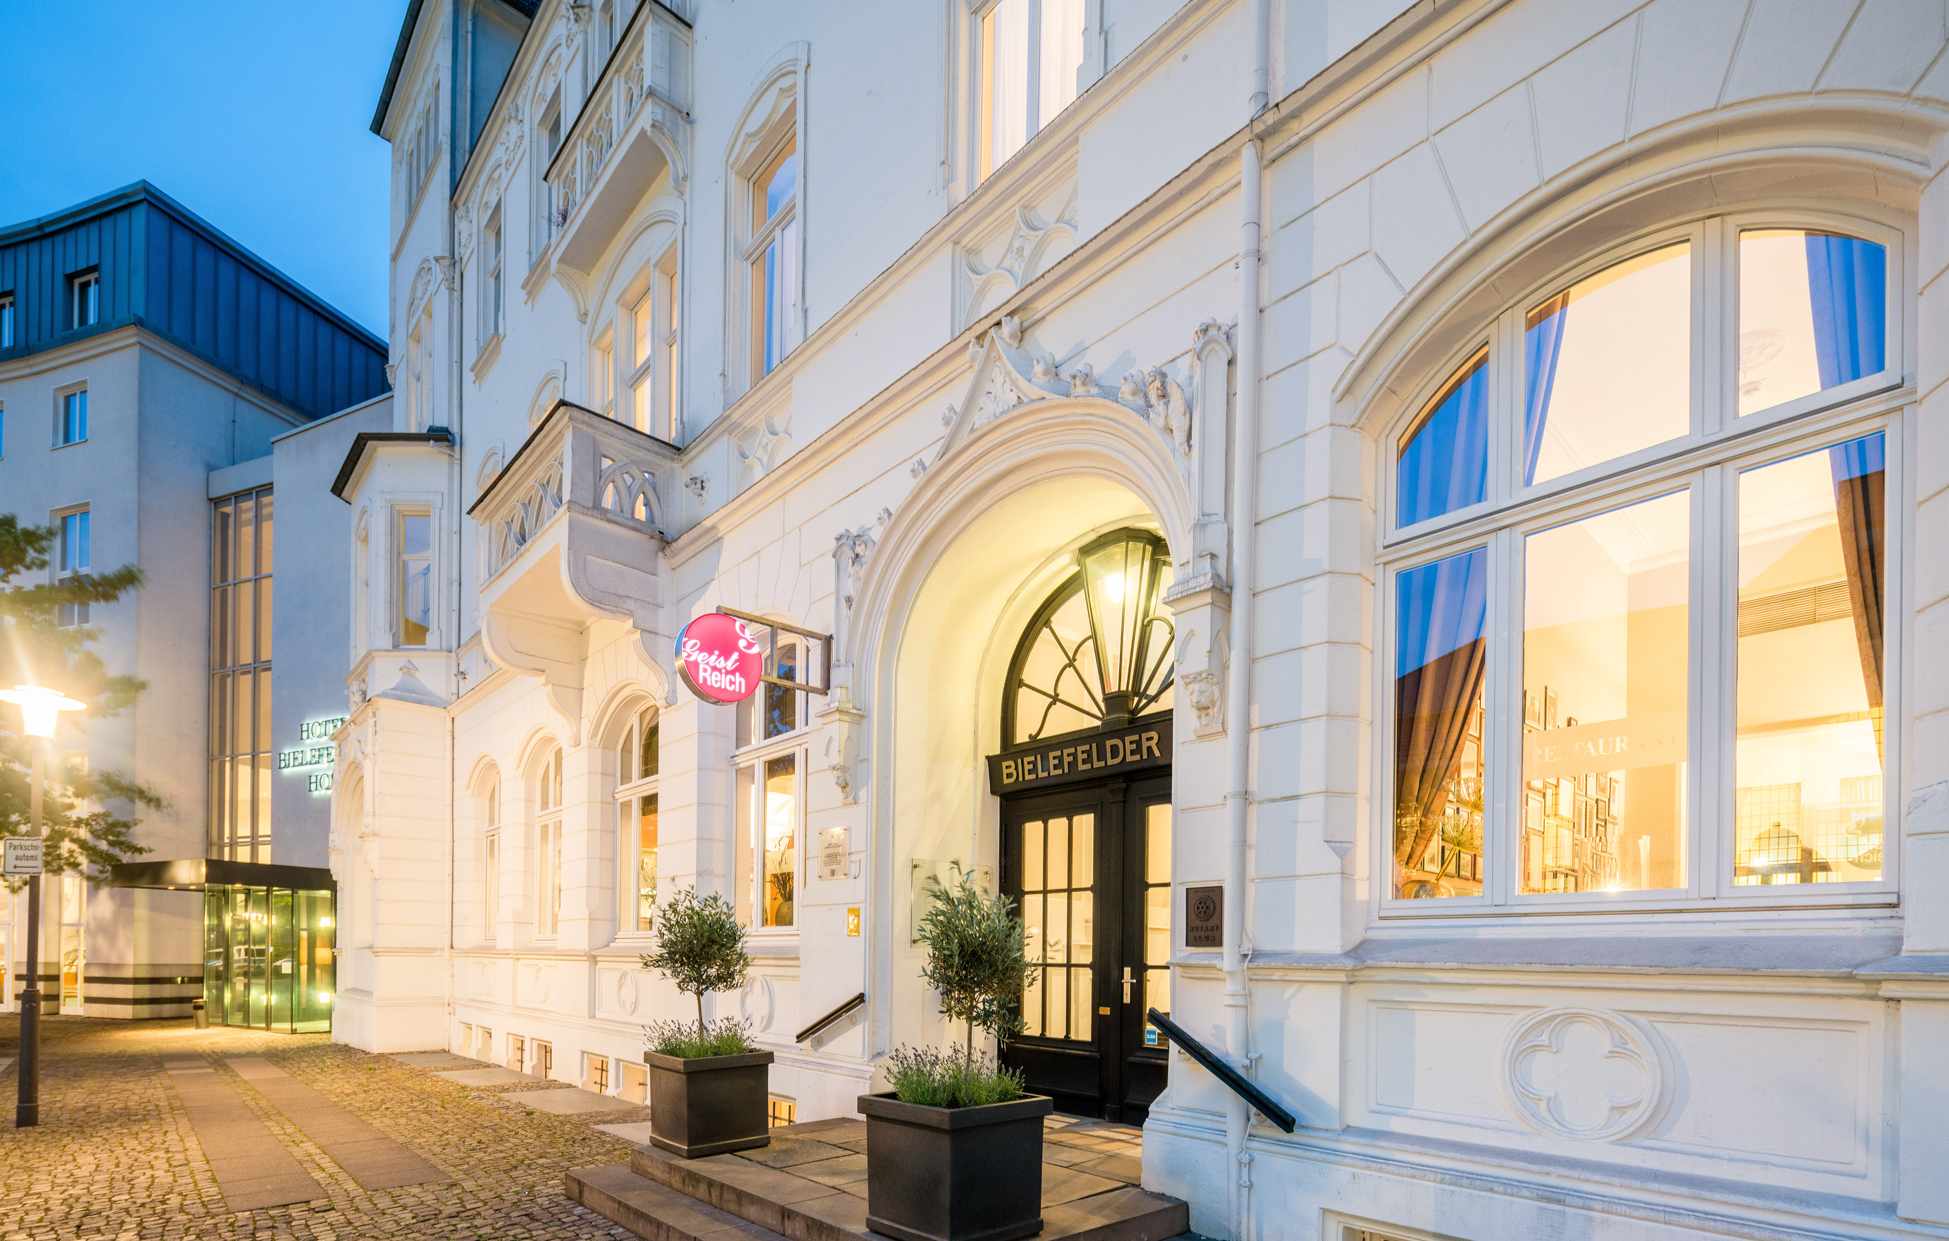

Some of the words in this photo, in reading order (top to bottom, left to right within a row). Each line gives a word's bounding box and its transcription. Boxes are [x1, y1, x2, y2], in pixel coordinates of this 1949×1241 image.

[682, 639, 740, 671] Geist
[698, 664, 746, 694] Reich
[299, 716, 347, 741] HOTE
[1001, 731, 1161, 785] BIELEFELDER
